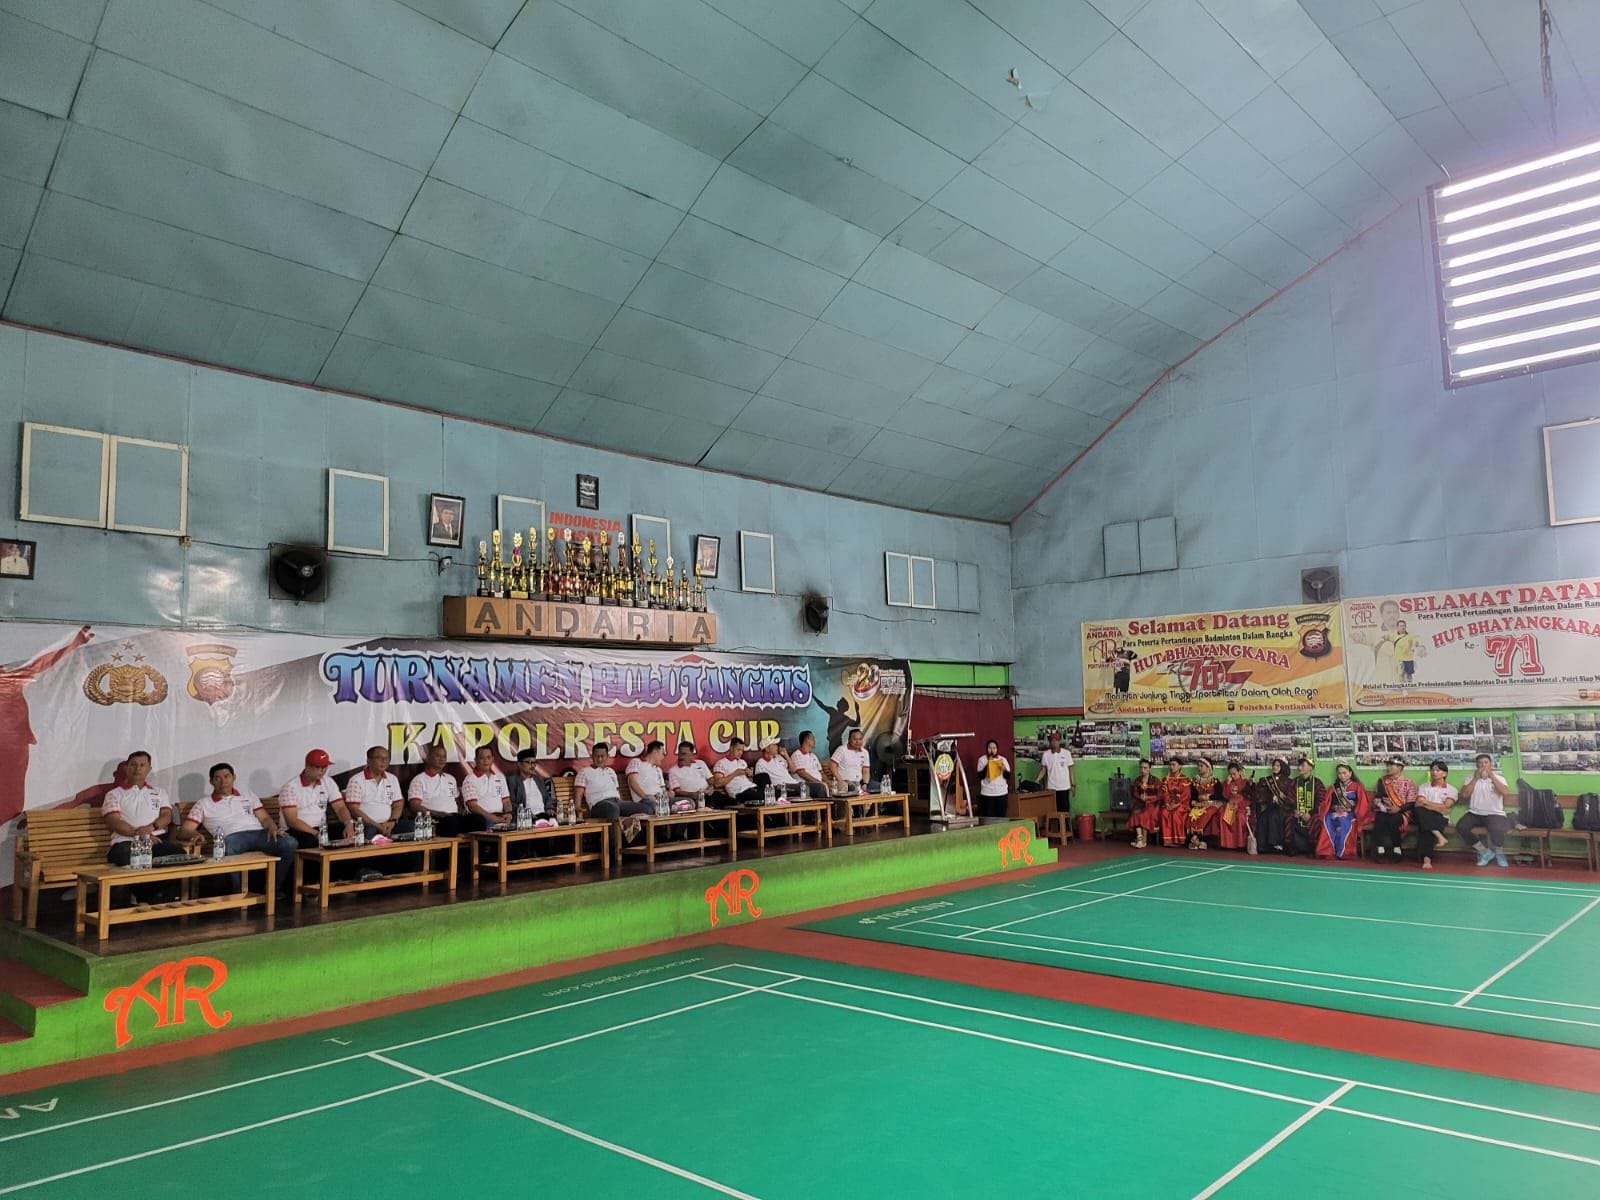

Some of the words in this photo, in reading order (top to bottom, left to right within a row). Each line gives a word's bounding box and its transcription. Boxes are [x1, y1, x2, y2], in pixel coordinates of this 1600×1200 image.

[549, 512, 621, 532] INDONESIA
[1399, 589, 1512, 613] SELAMAT
[1417, 613, 1434, 621] Para
[1435, 610, 1461, 619] Peserta
[1463, 606, 1512, 617] Pertandingan
[1513, 603, 1555, 613] Badminton
[1557, 602, 1582, 610] Dalam
[474, 600, 711, 641] ANDARIA
[1086, 629, 1123, 640] ANDARIA
[1127, 617, 1206, 636] Selamat
[1212, 612, 1290, 630] Datang
[1432, 625, 1465, 648] HUT
[1467, 615, 1600, 637] BHAYANGKARA
[1122, 639, 1136, 648] Para
[1137, 638, 1160, 648] Peserta
[1161, 635, 1203, 646] Pertandingan
[1204, 632, 1241, 642] Badminton
[1242, 630, 1265, 640] Dalam
[1266, 628, 1293, 639] Rangka
[1133, 652, 1162, 674] HUT
[1165, 643, 1291, 669] BHAYANGKARA
[1484, 633, 1544, 677] 71
[323, 652, 585, 704] TURNAMEN
[590, 660, 811, 705] BULUTANGKIS
[1184, 659, 1219, 690] 70
[1140, 691, 1168, 704] Junjung
[1241, 688, 1270, 699] Dalam
[1271, 687, 1294, 698] Olah
[1294, 686, 1319, 701] Raga
[1274, 701, 1317, 711] Pontianak
[1318, 700, 1344, 710] Utara
[387, 719, 696, 766] KAPOLRESTA
[997, 825, 1035, 869] AR
[704, 868, 763, 928] AR
[103, 956, 233, 1049] AR
